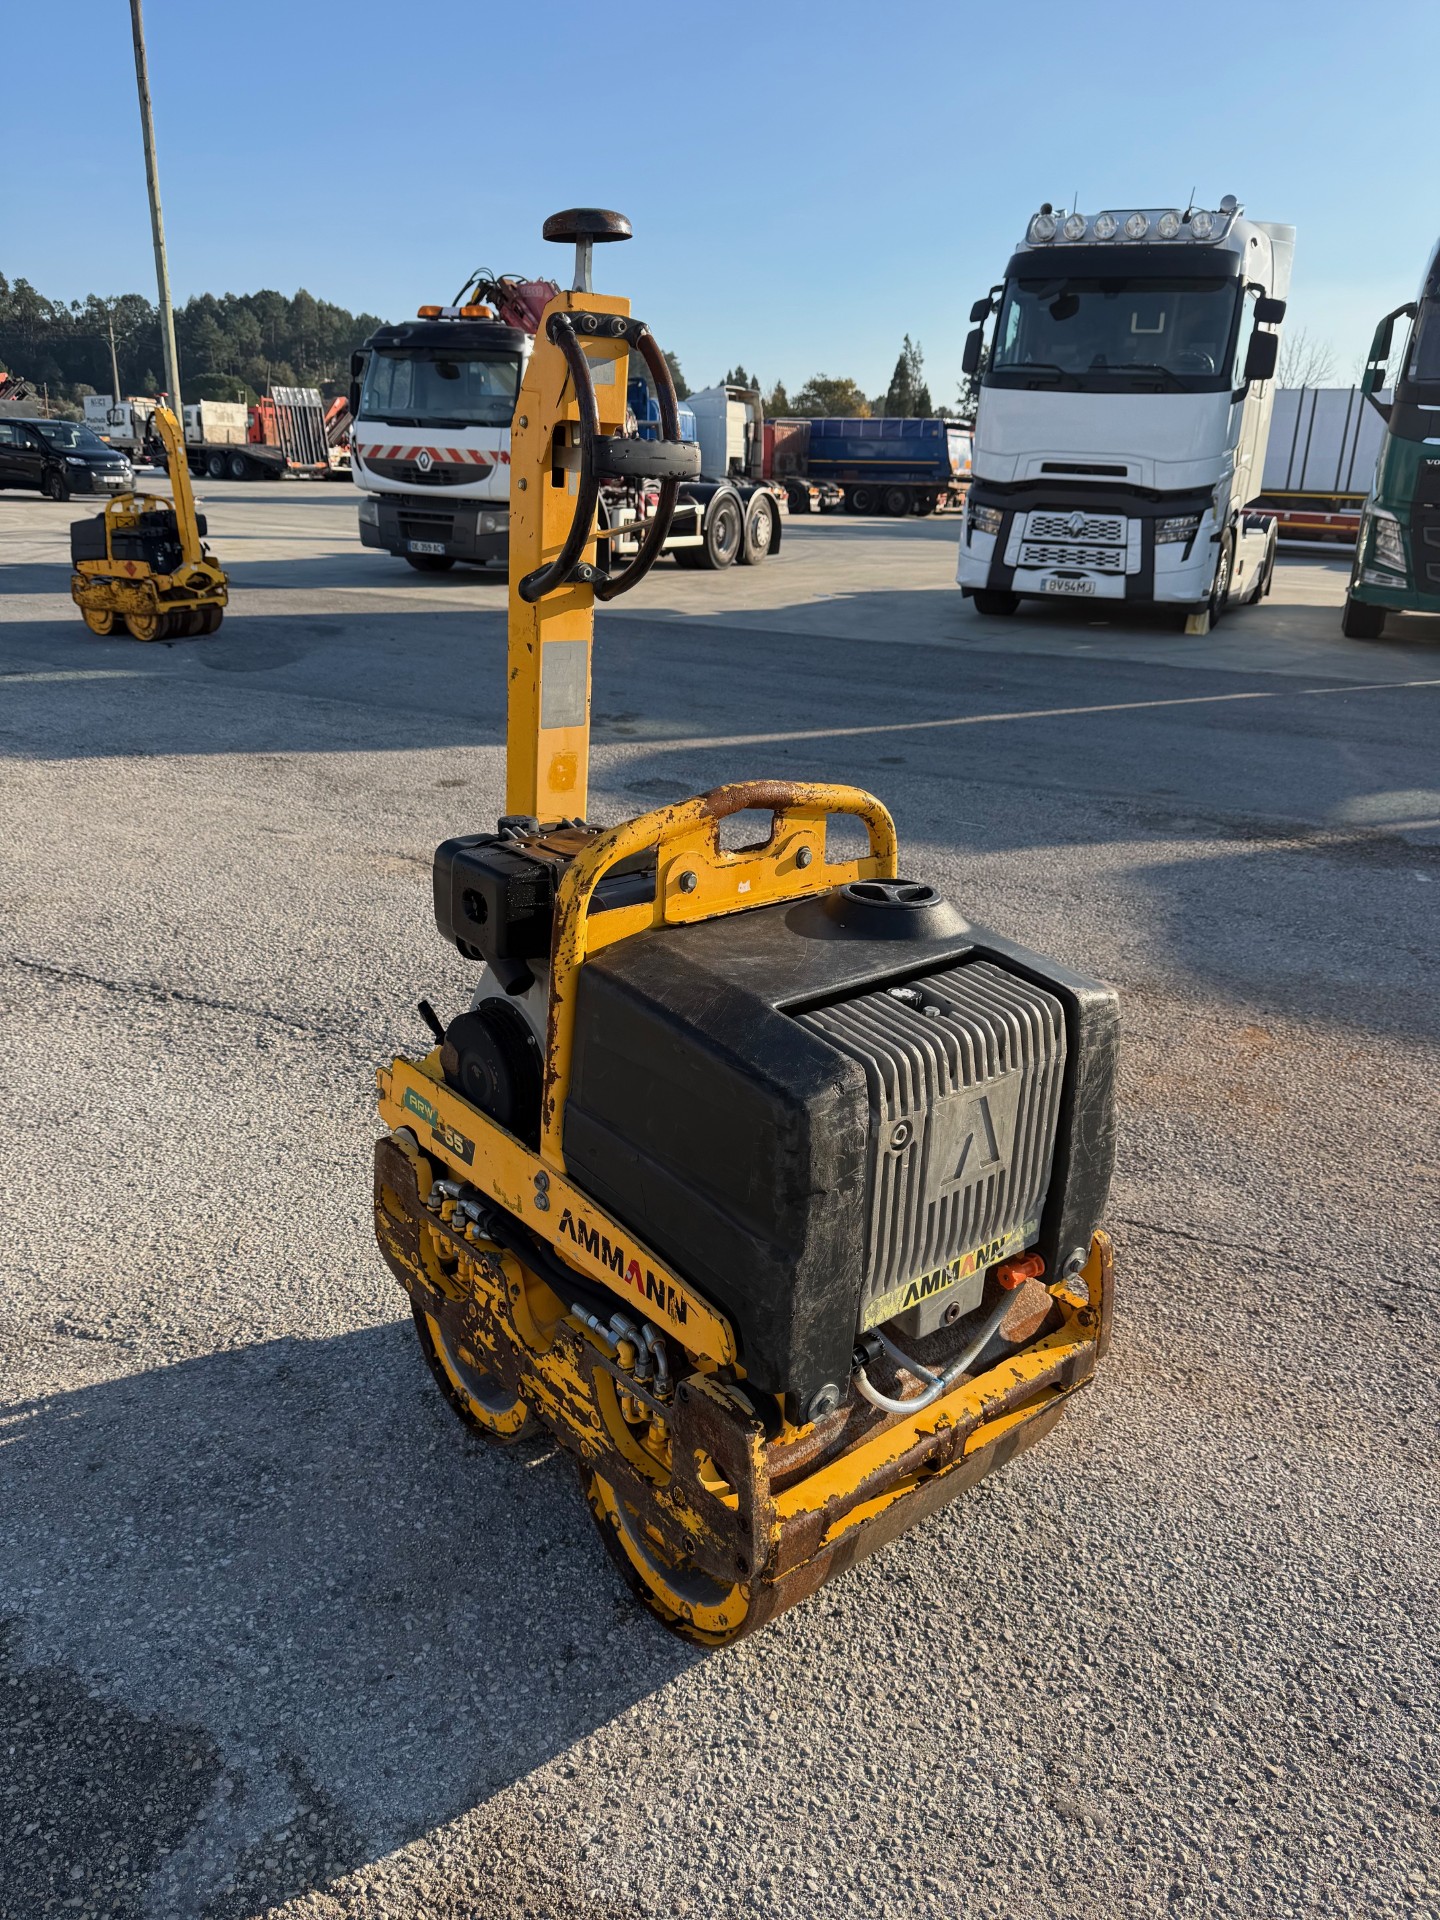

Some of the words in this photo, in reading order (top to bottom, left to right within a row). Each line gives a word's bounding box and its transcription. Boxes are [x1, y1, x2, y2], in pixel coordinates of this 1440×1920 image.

[409, 1094, 433, 1119] ARW
[445, 1130, 464, 1154] 65
[559, 1208, 687, 1325] AMMANN
[903, 1237, 1006, 1308] AMMANN
